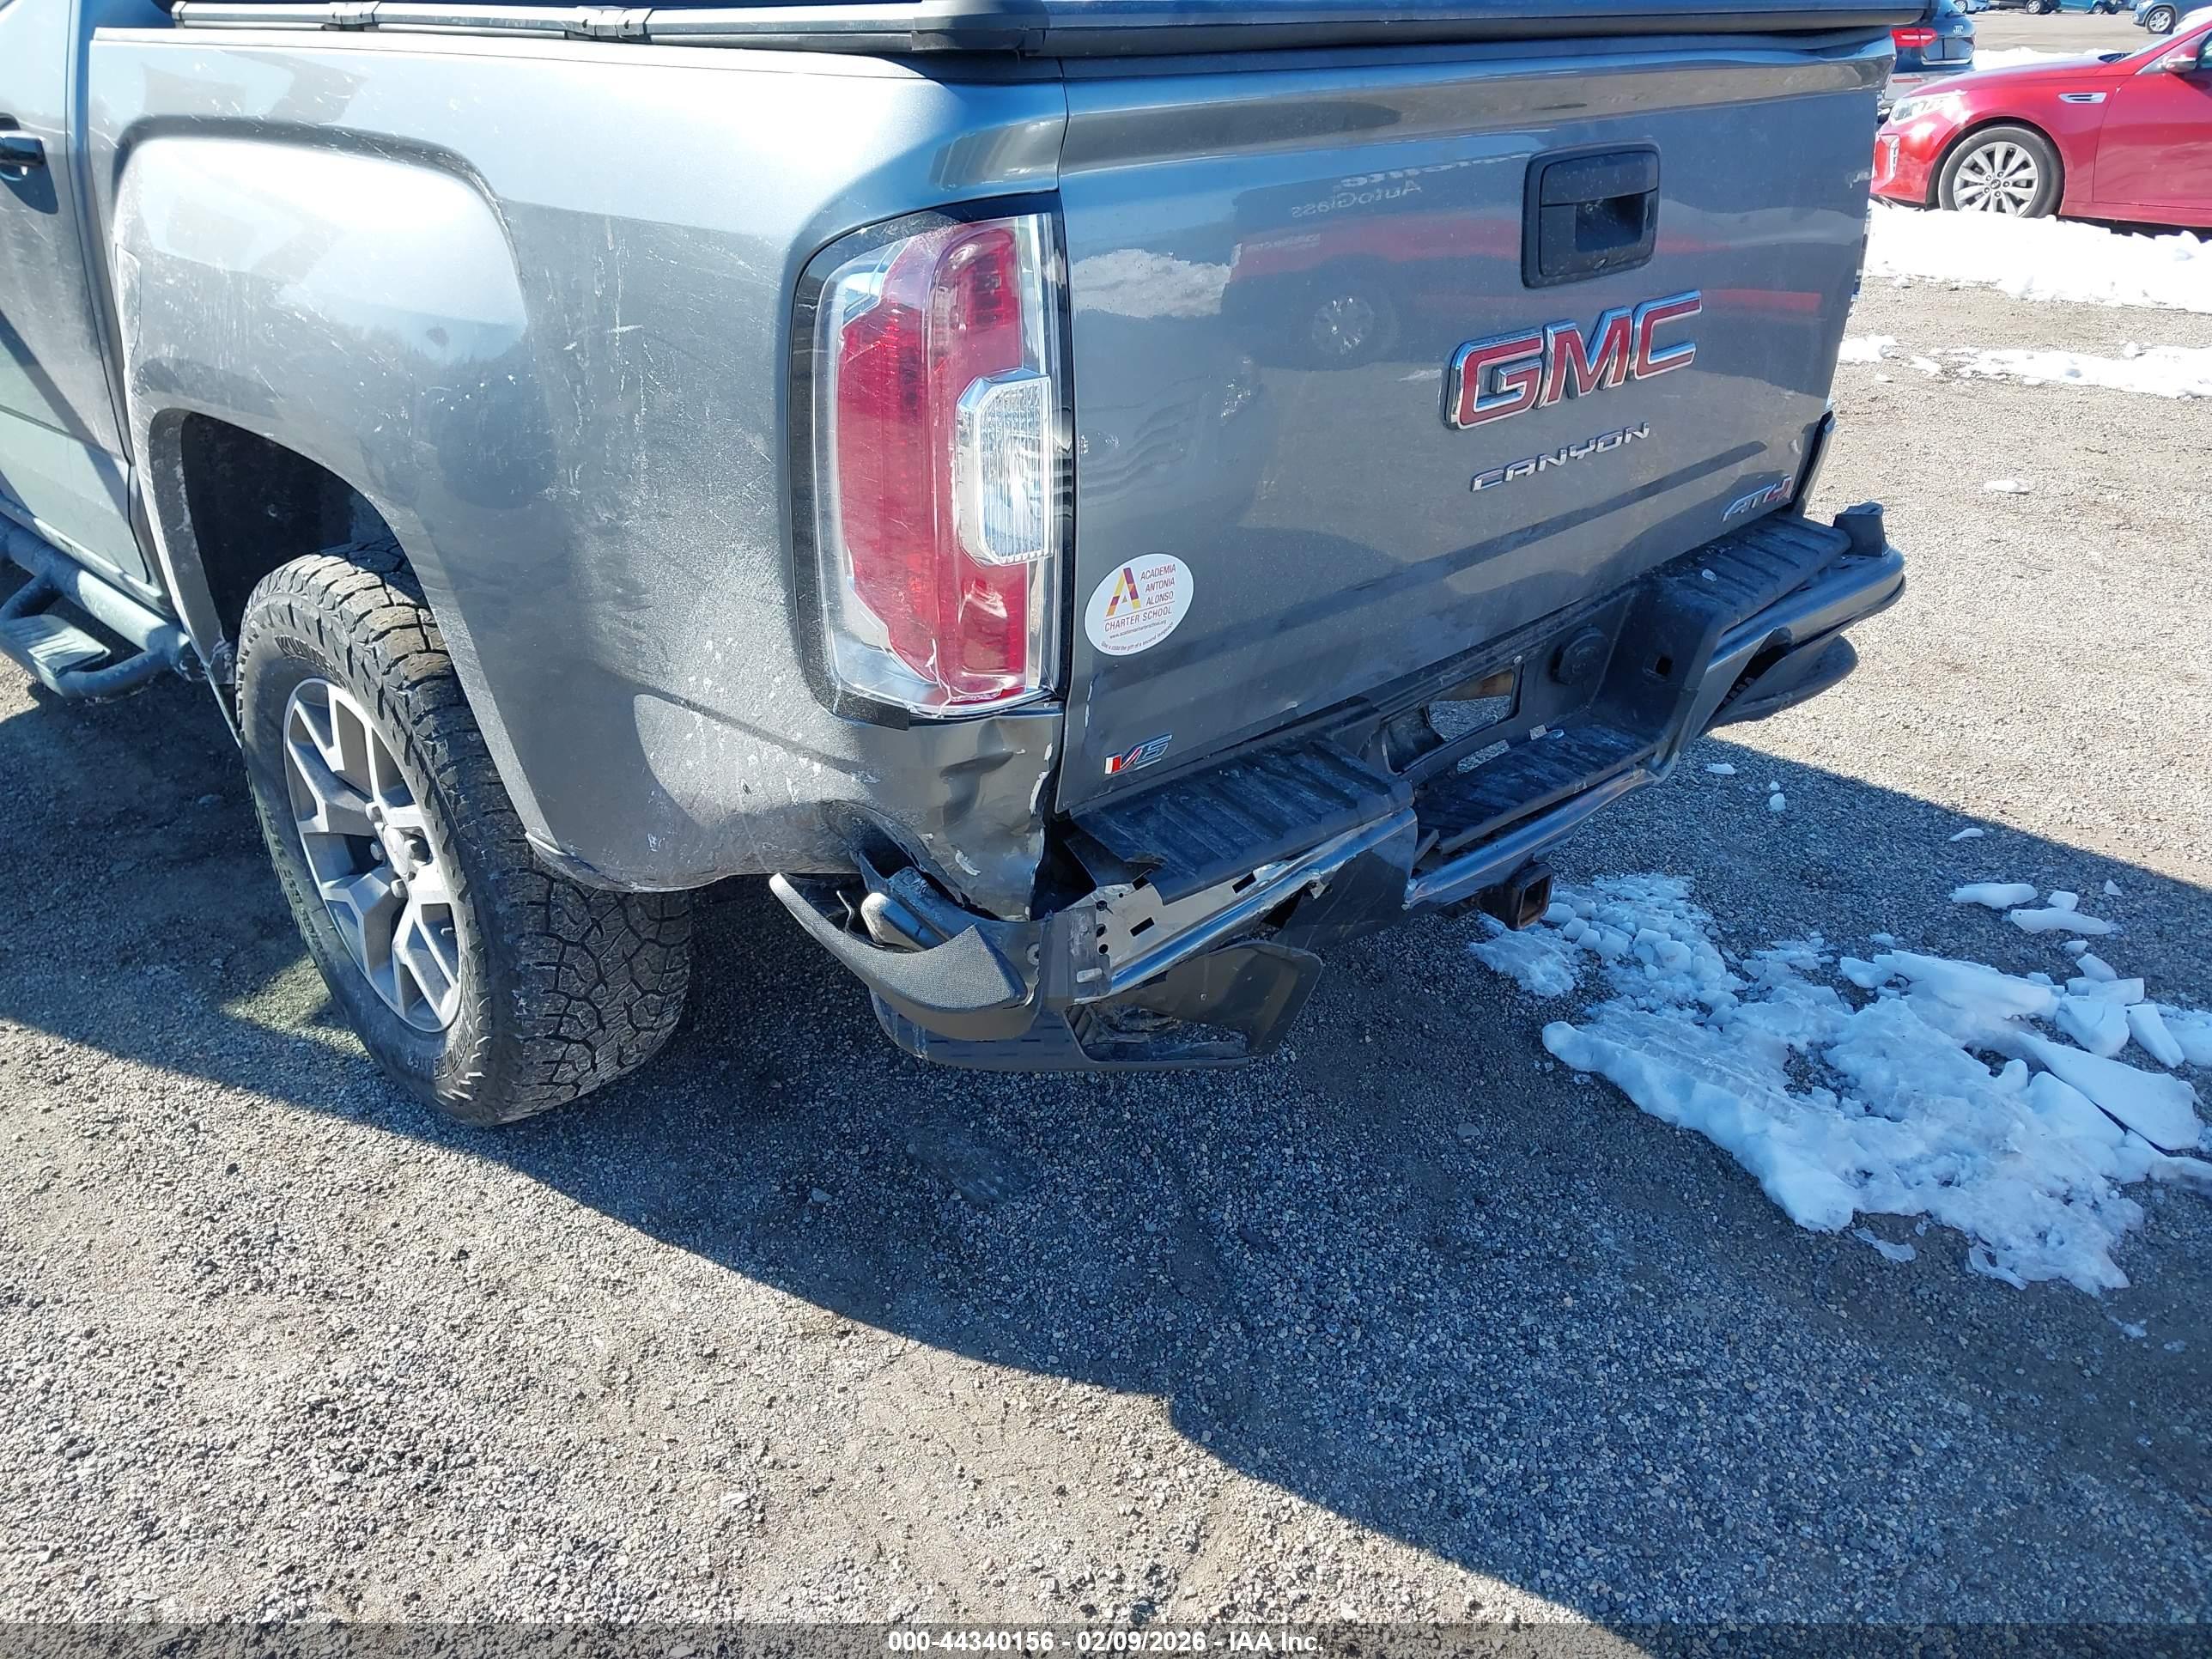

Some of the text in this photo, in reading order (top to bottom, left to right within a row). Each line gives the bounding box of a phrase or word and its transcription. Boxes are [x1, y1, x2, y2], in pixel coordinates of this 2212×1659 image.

[1445, 289, 1702, 428] GMC
[1470, 422, 1650, 492] CANYON
[1722, 474, 1792, 522] AT4
[1140, 563, 1176, 580] ACADEMIA
[1146, 577, 1175, 592] ANTONIA
[1146, 591, 1174, 605] ALONSO
[1104, 605, 1172, 632] CHARTER SCHOOL
